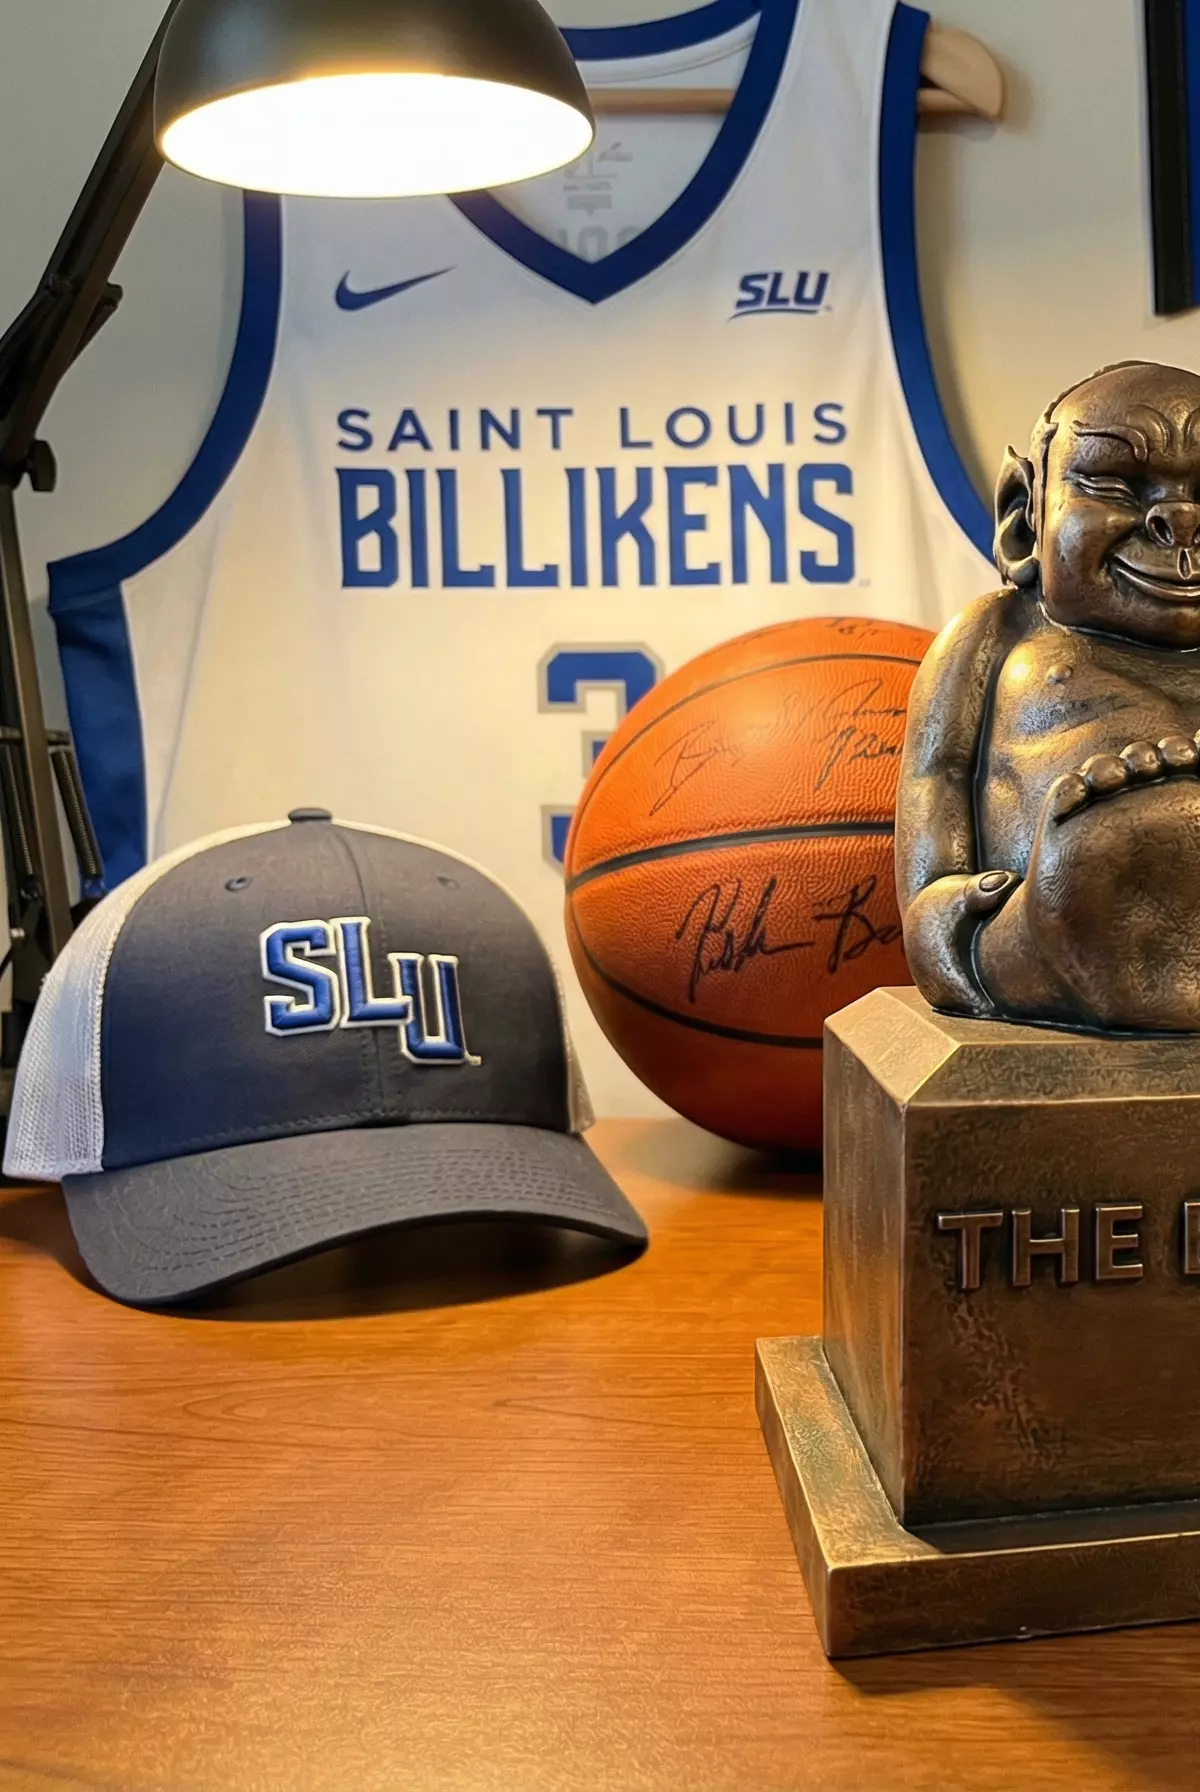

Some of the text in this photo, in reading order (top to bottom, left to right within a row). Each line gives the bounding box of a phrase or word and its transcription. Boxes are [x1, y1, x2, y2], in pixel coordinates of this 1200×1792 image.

[735, 271, 829, 309] SLU
[336, 402, 848, 452] SAINT LOUIS
[335, 462, 856, 588] BILLIKENS
[259, 916, 467, 1066] SLU
[937, 1204, 1144, 1291] THE
